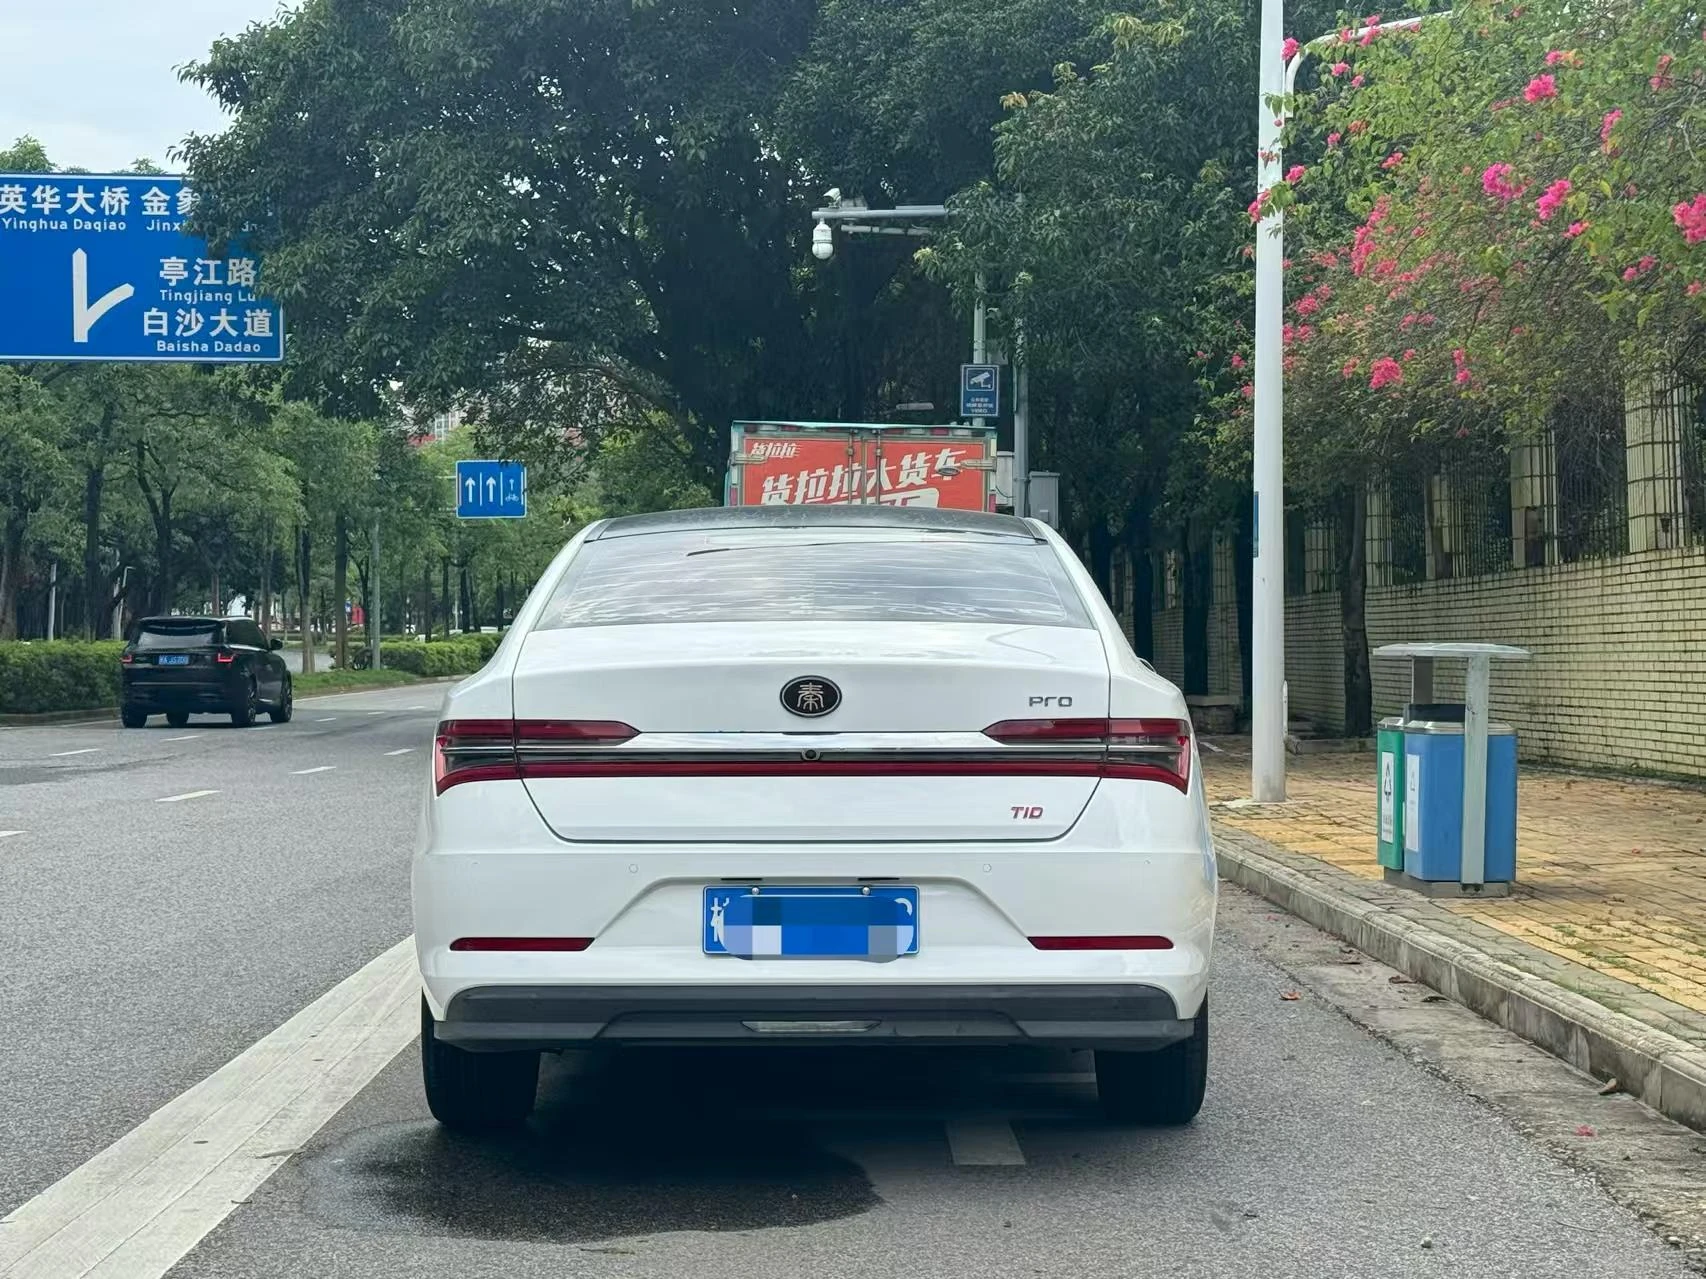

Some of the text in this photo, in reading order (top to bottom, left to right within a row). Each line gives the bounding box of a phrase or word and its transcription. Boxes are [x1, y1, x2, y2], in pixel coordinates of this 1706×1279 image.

[0, 184, 201, 216] 英华大桥 金象
[2, 218, 69, 233] Yinghua
[73, 218, 127, 232] Daqiao
[159, 256, 256, 287] 亭江路
[159, 289, 257, 305] Tingjiang Lu
[143, 307, 273, 337] 白沙大道
[156, 340, 261, 353] Baisha Dadao
